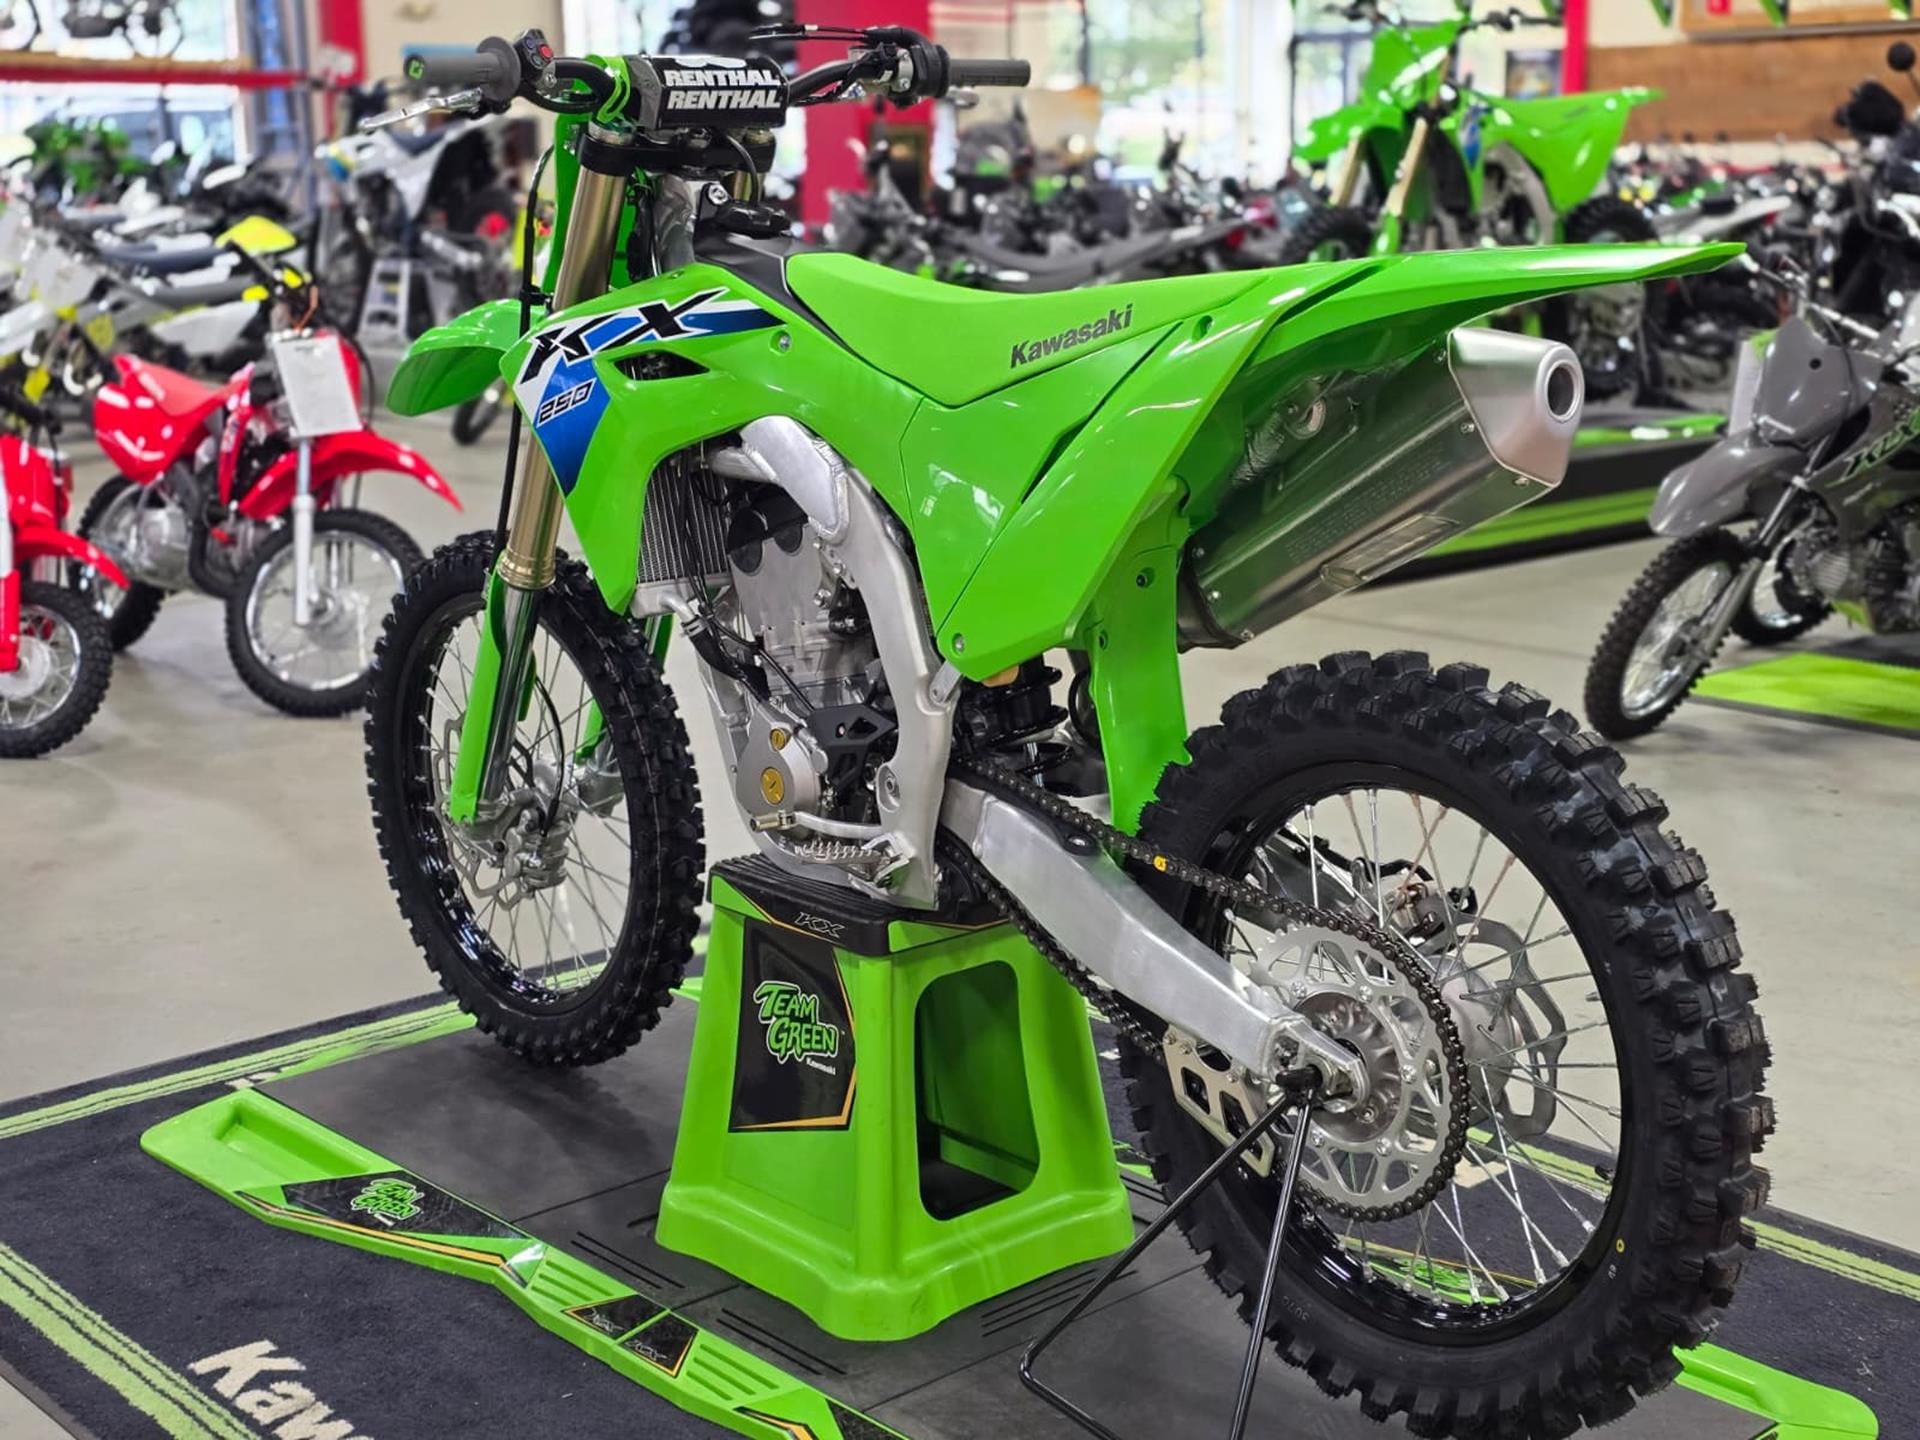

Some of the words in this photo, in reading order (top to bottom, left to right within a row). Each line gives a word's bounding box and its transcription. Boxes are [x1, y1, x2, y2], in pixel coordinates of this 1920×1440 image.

[663, 69, 781, 87] RENTHAL
[667, 89, 781, 110] RENTHAL
[520, 286, 729, 385] KX
[1010, 303, 1133, 369] Kawasaki
[538, 379, 596, 427] 250
[794, 911, 845, 938] KX
[754, 982, 819, 1024] TEAM
[768, 1017, 839, 1060] GREEN
[350, 1193, 420, 1220] GREEN
[187, 1339, 374, 1440] Kaw
